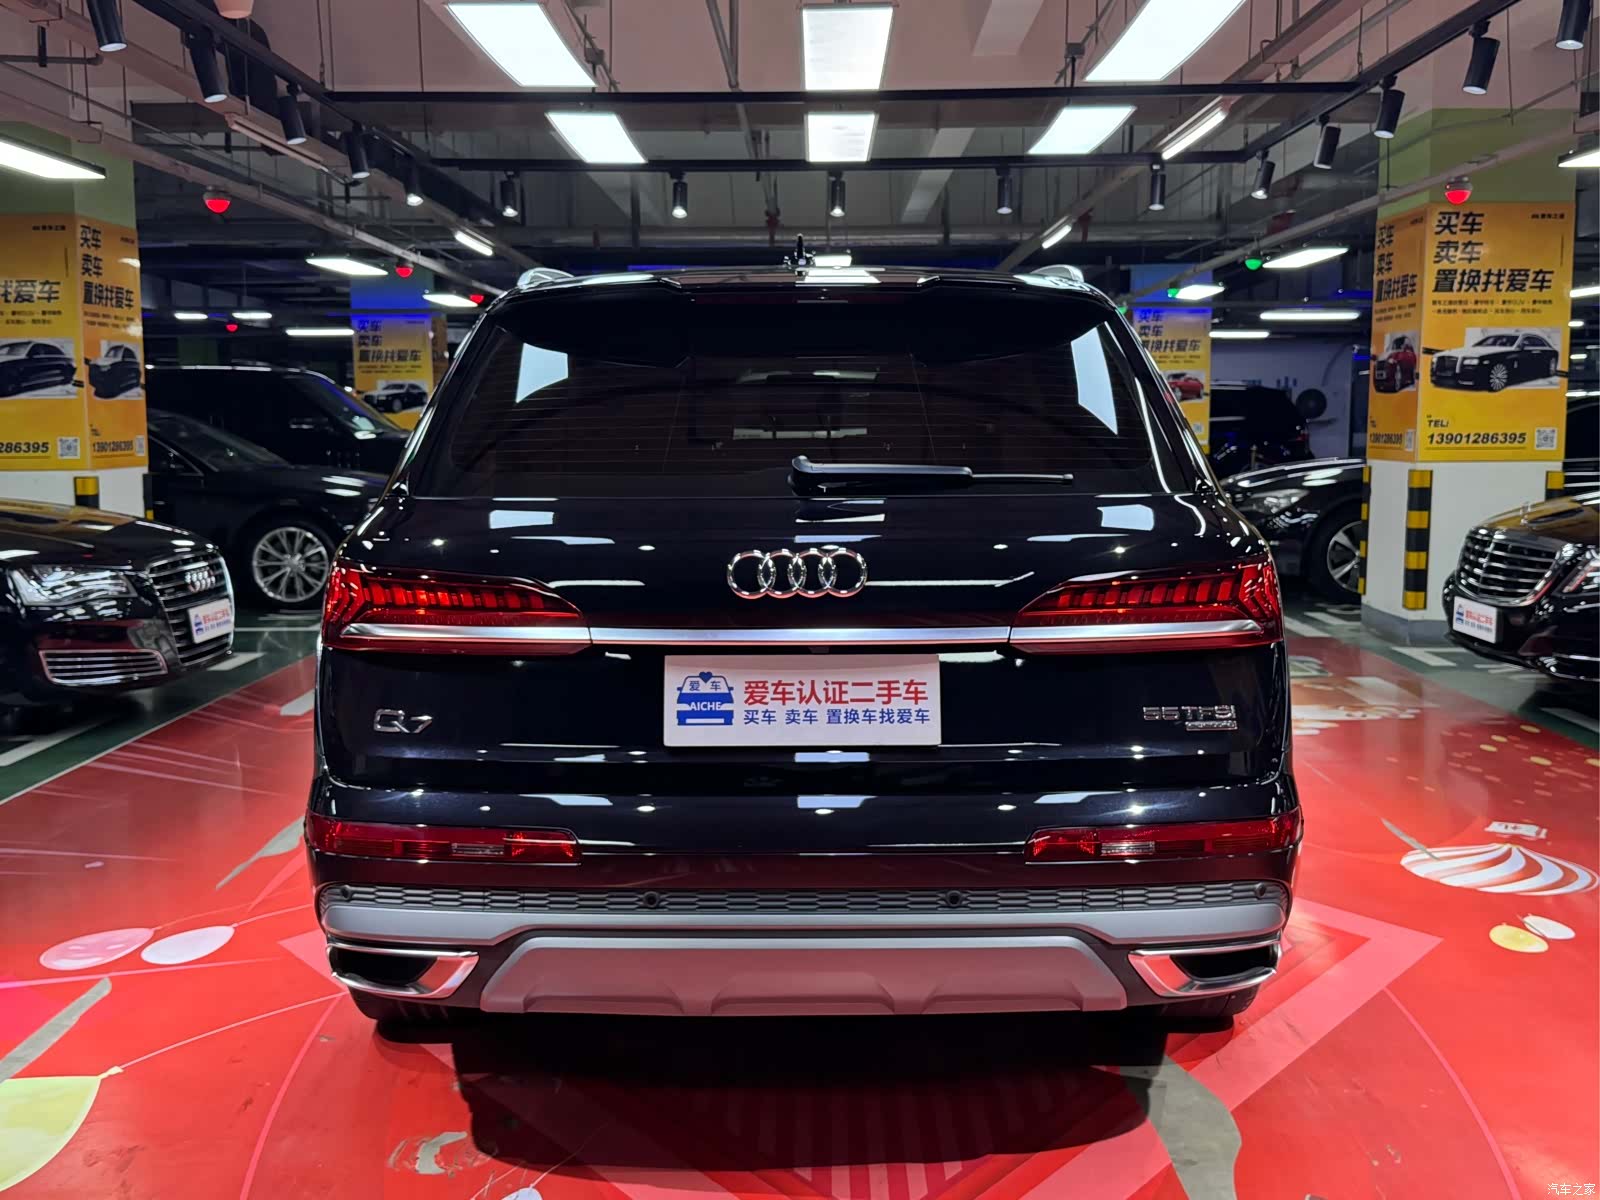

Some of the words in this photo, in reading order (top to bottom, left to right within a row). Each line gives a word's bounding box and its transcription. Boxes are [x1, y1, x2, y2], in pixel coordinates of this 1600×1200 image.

[1434, 211, 1484, 235] 买车
[80, 225, 101, 249] 买车
[1377, 224, 1394, 249] 买车
[1433, 240, 1483, 264] 卖车
[82, 253, 103, 277] 卖车
[1432, 268, 1554, 293] 置换找爱车
[1427, 432, 1526, 444] 13901286395
[743, 679, 928, 706] 爱车认证二手车
[690, 701, 722, 711] AICHE
[743, 709, 777, 725] 买车
[785, 709, 819, 725] 卖车
[826, 708, 931, 725] 置换车找爱车
[374, 708, 433, 734] Q7
